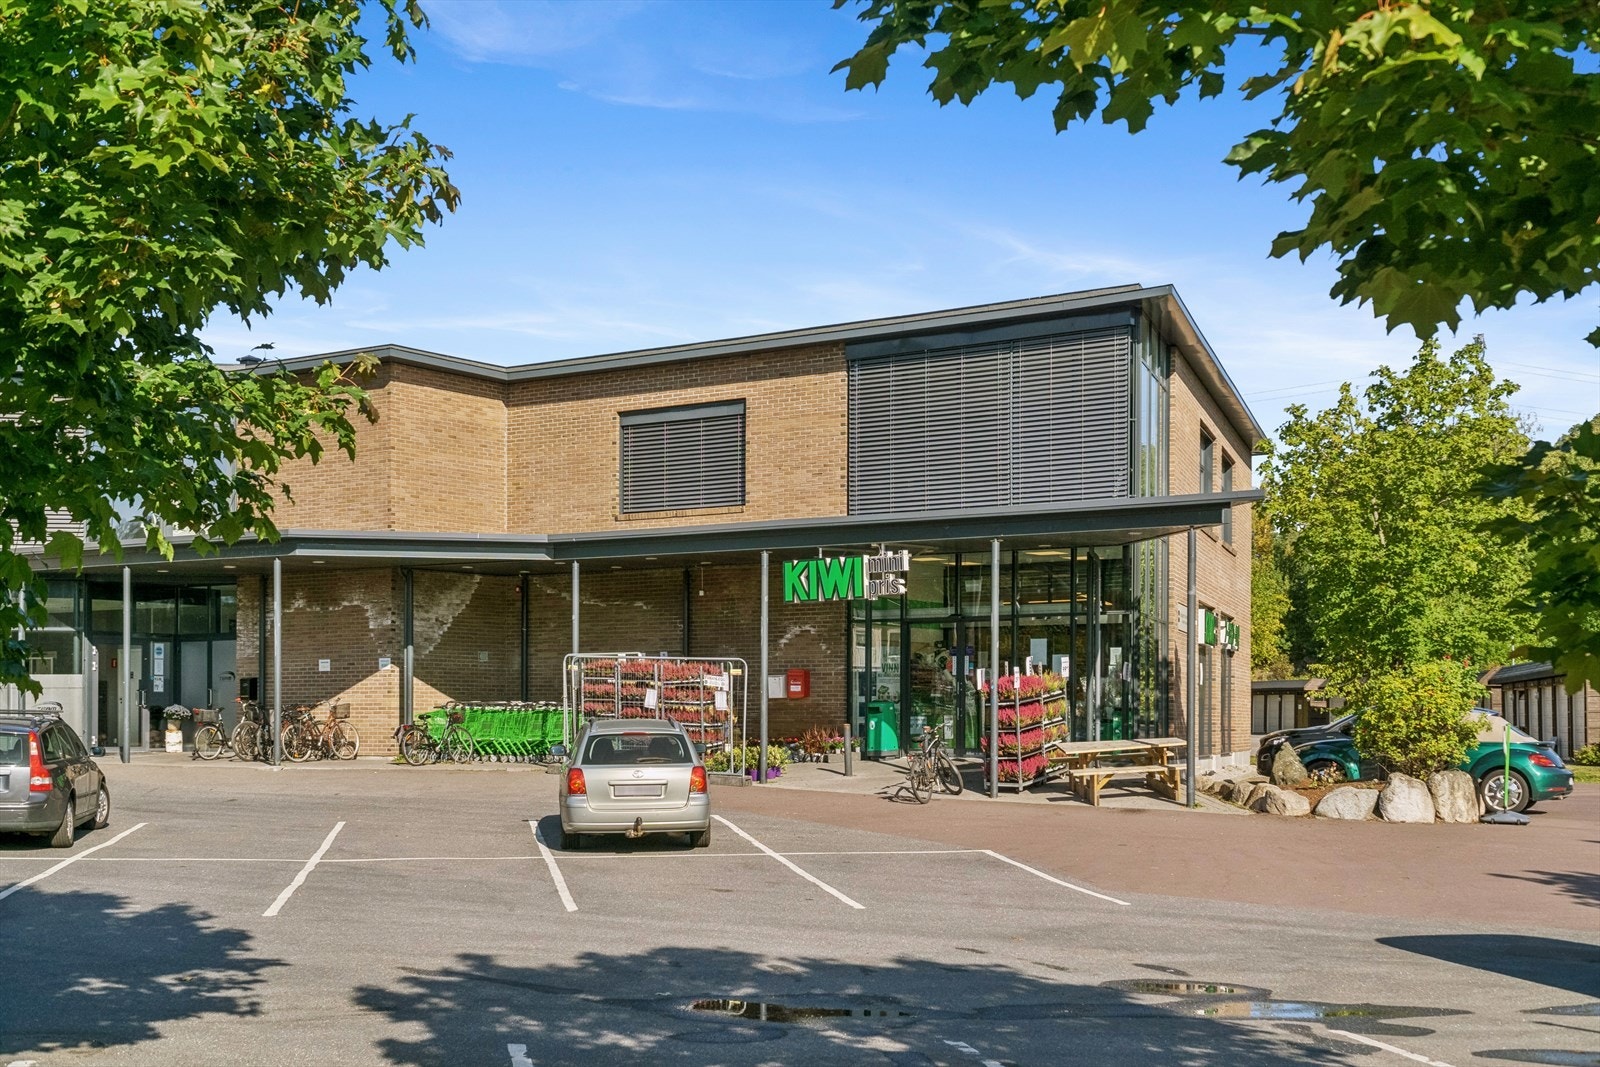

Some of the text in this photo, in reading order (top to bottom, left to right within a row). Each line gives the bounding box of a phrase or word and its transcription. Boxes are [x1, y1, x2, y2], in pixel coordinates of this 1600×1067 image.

[868, 549, 905, 573] mini
[783, 556, 864, 603] KIWI
[868, 573, 901, 600] pris
